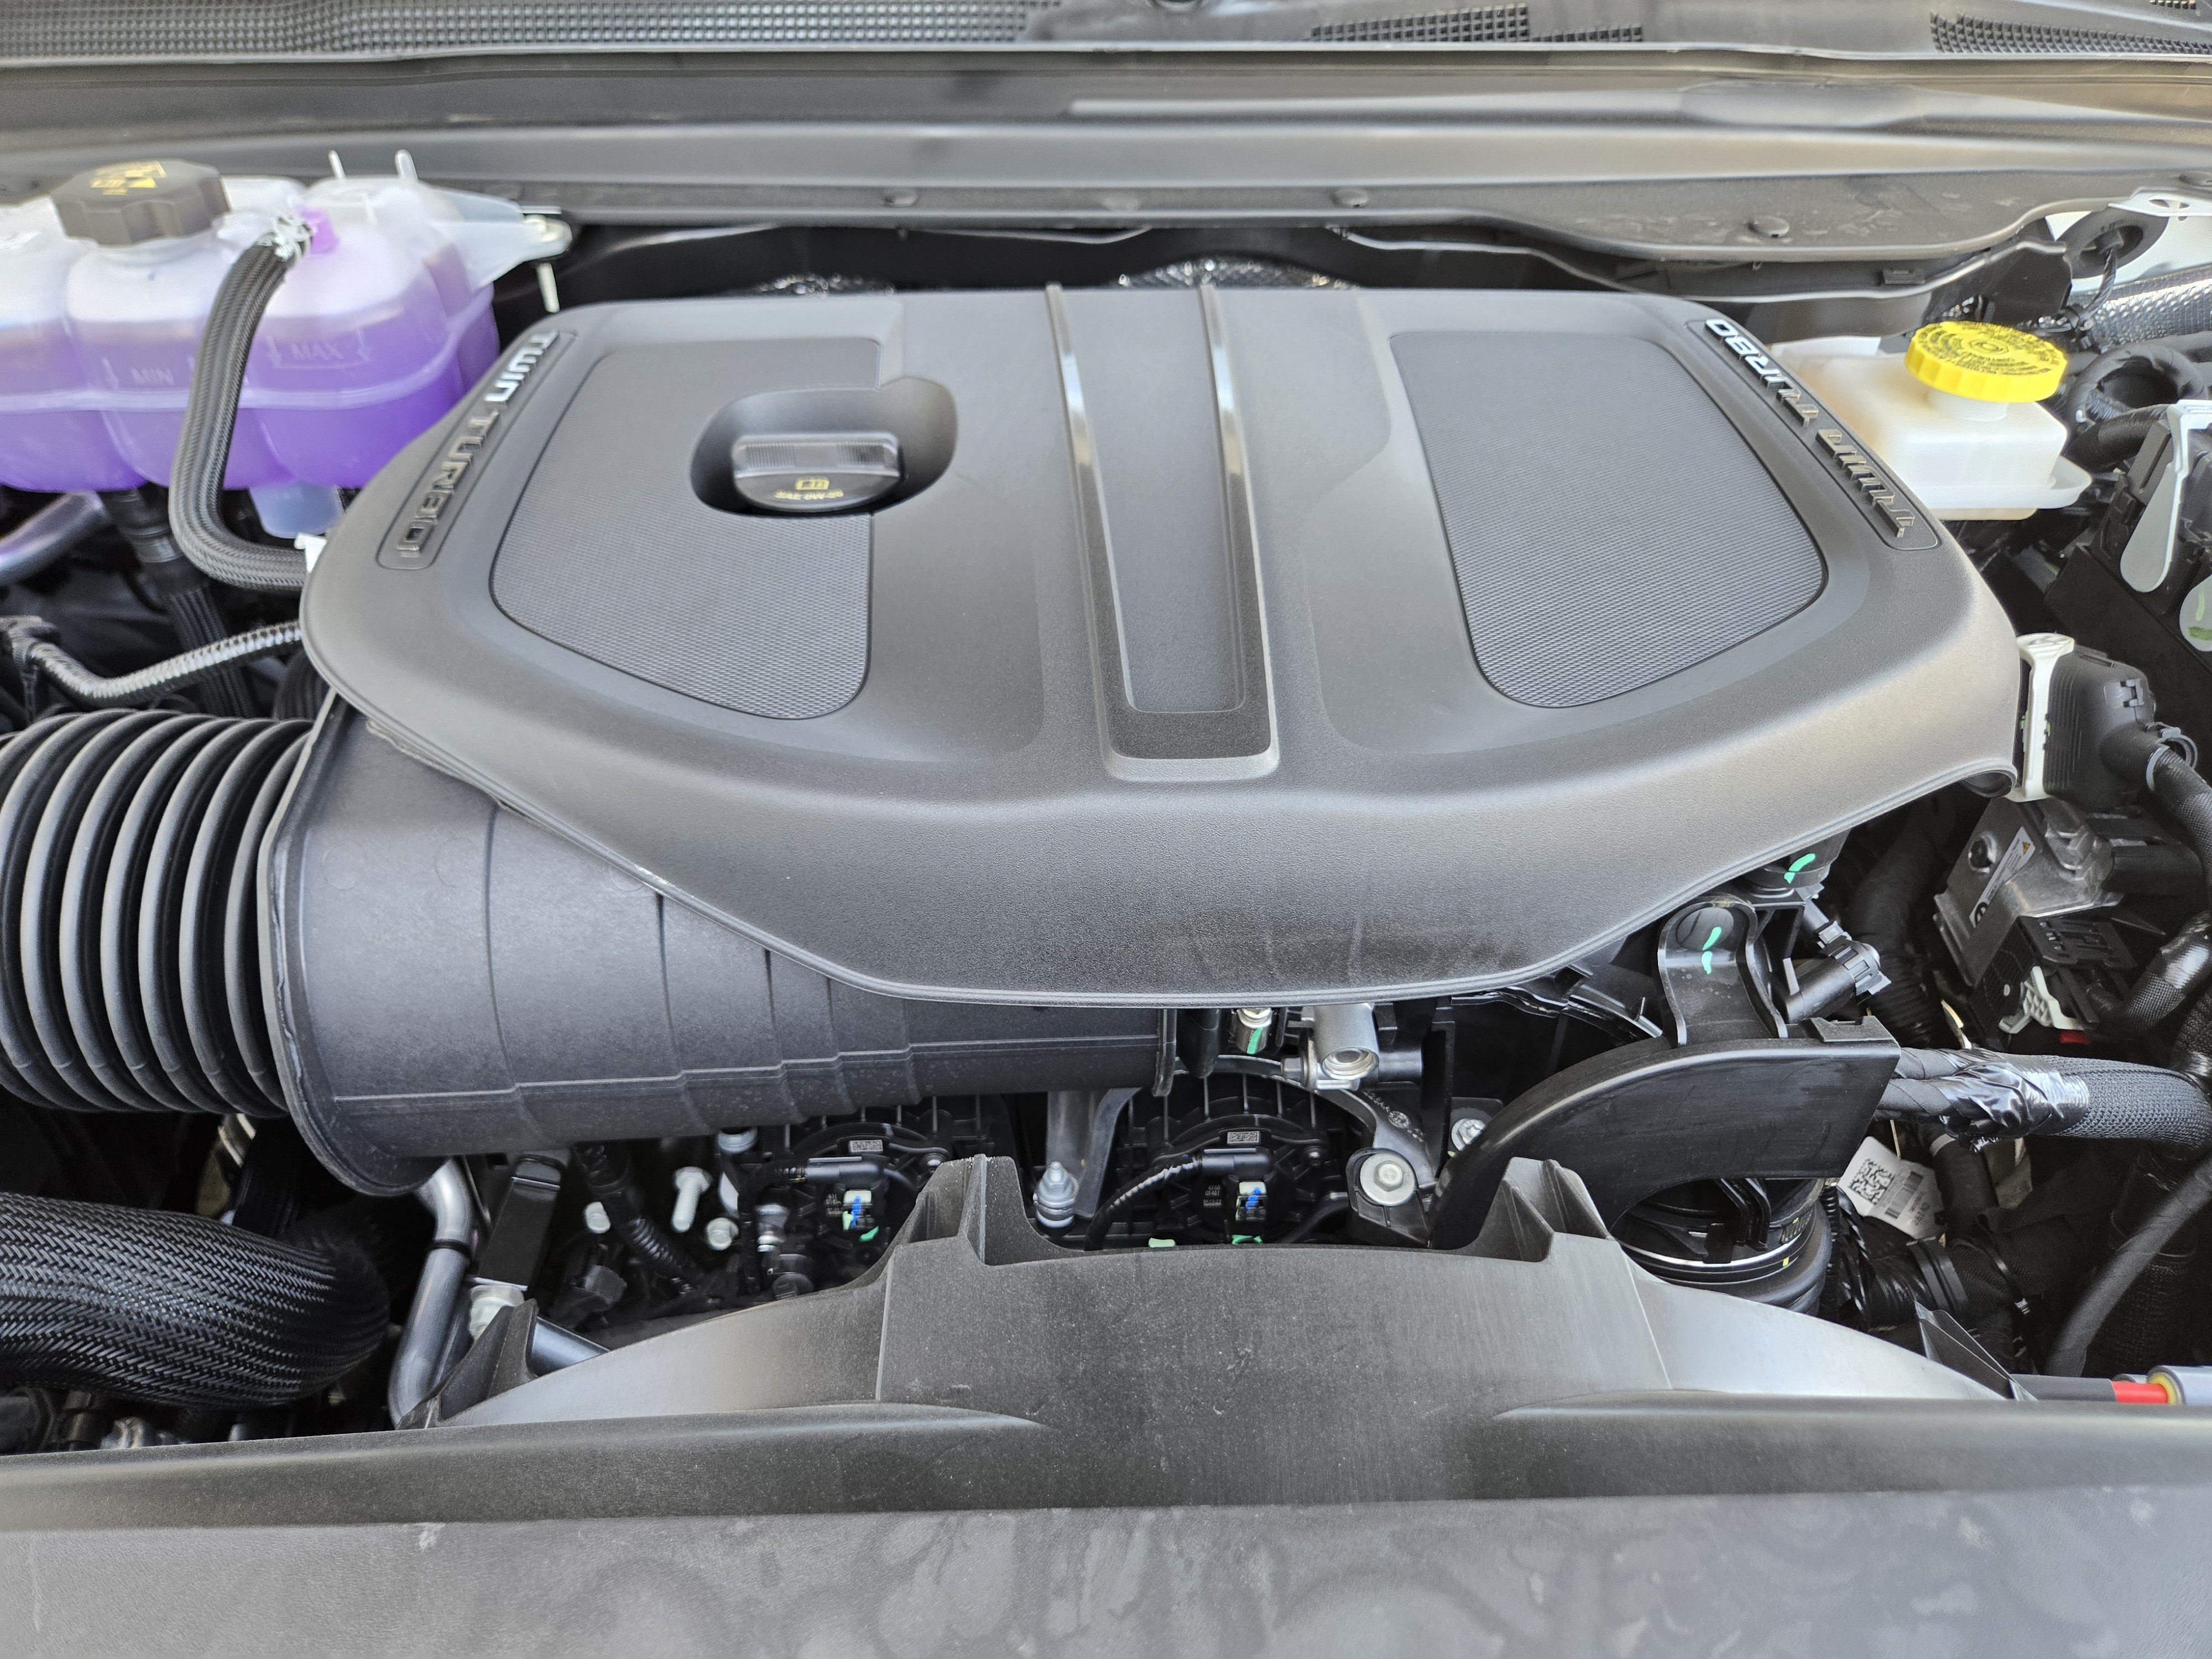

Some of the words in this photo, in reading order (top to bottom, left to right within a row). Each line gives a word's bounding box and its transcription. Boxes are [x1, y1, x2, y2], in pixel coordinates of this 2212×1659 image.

[130, 367, 175, 385] MIN
[290, 341, 344, 362] MAX
[484, 329, 560, 408] TWIN
[1704, 318, 1819, 426] TURBO
[396, 410, 500, 559] TURBO
[1814, 429, 1915, 538] TWIN
